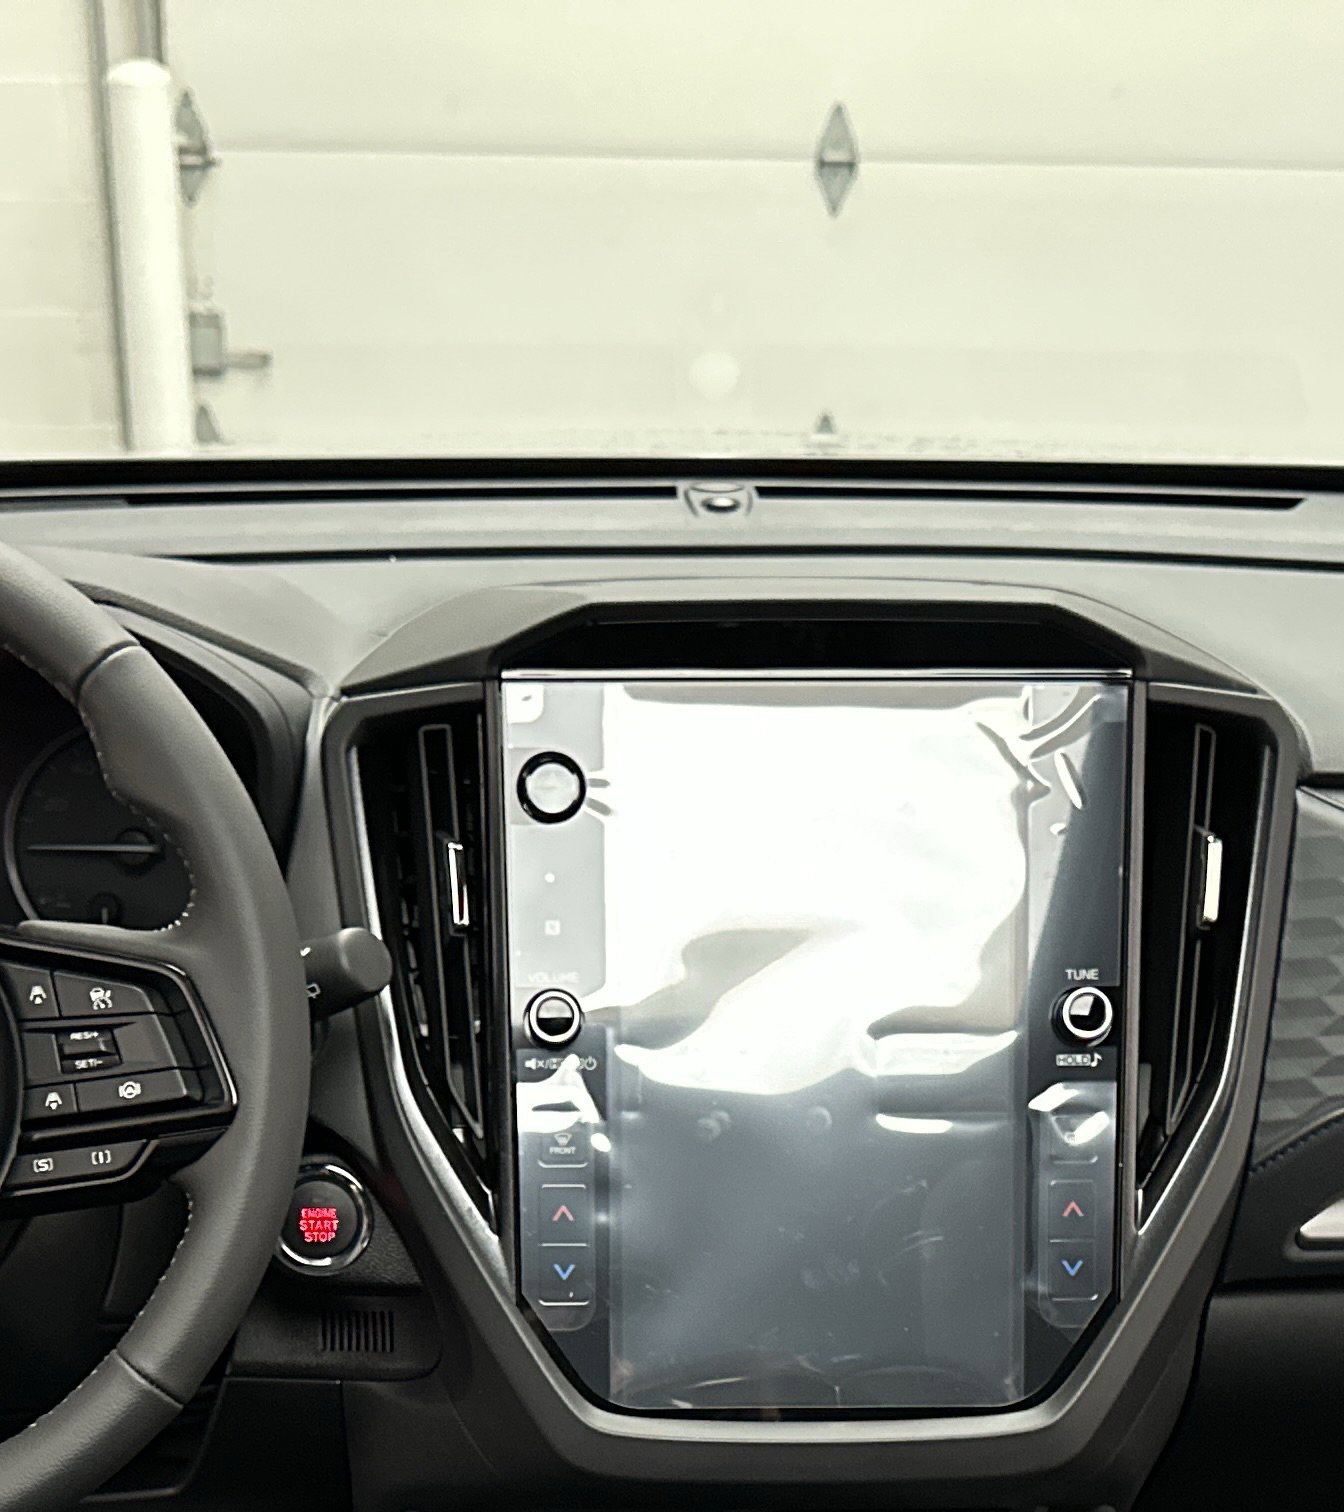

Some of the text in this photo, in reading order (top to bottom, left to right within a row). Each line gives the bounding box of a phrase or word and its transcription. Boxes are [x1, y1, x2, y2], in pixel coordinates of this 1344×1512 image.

[528, 971, 579, 983] VOLUME
[1065, 969, 1099, 981] TUNE
[301, 1208, 337, 1218] ENGINE
[299, 1220, 339, 1231] START
[304, 1232, 336, 1243] STOP
